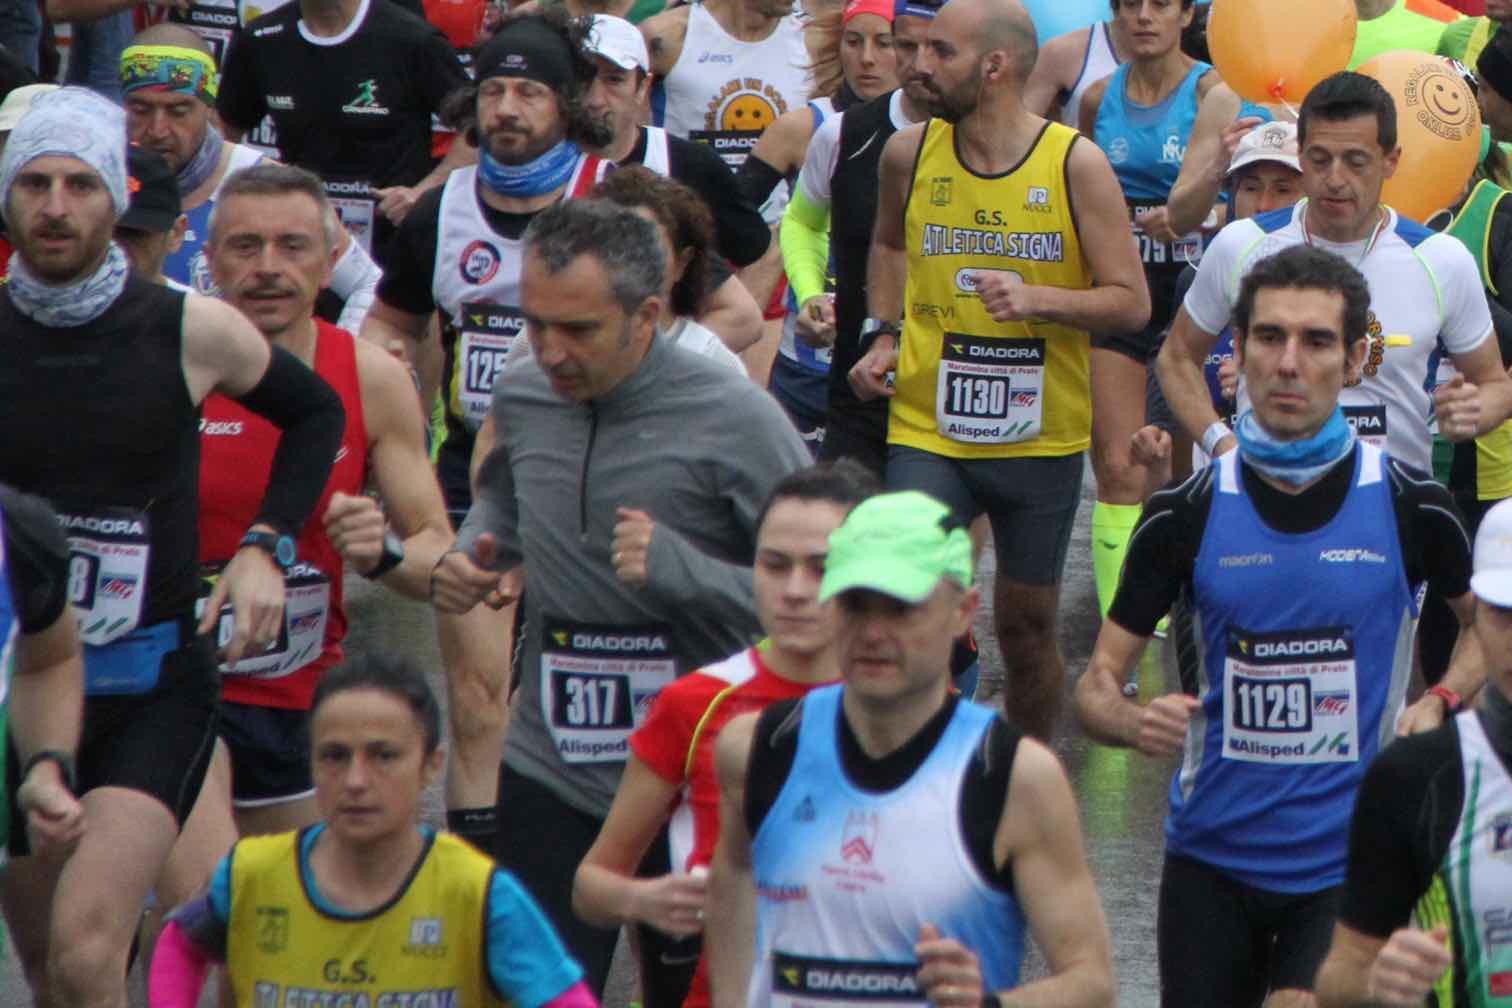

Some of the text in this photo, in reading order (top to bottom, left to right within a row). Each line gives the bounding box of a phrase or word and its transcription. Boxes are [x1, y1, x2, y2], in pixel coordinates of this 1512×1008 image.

[322, 181, 369, 193] ADORA
[974, 209, 1008, 227] G.S.
[921, 223, 1064, 263] ATLETICA SIGNA
[969, 344, 1041, 359] DIADORA
[951, 376, 1006, 416] 1130
[948, 422, 1001, 438] Alisped
[573, 633, 667, 652] DIADORA
[1254, 637, 1349, 657] DIADORA
[566, 677, 617, 726] 317
[1238, 682, 1308, 728] 1129
[559, 738, 628, 756] Alisped
[1238, 738, 1305, 760] Alisped
[322, 958, 378, 984] G.S.
[806, 969, 918, 992] DIADORA
